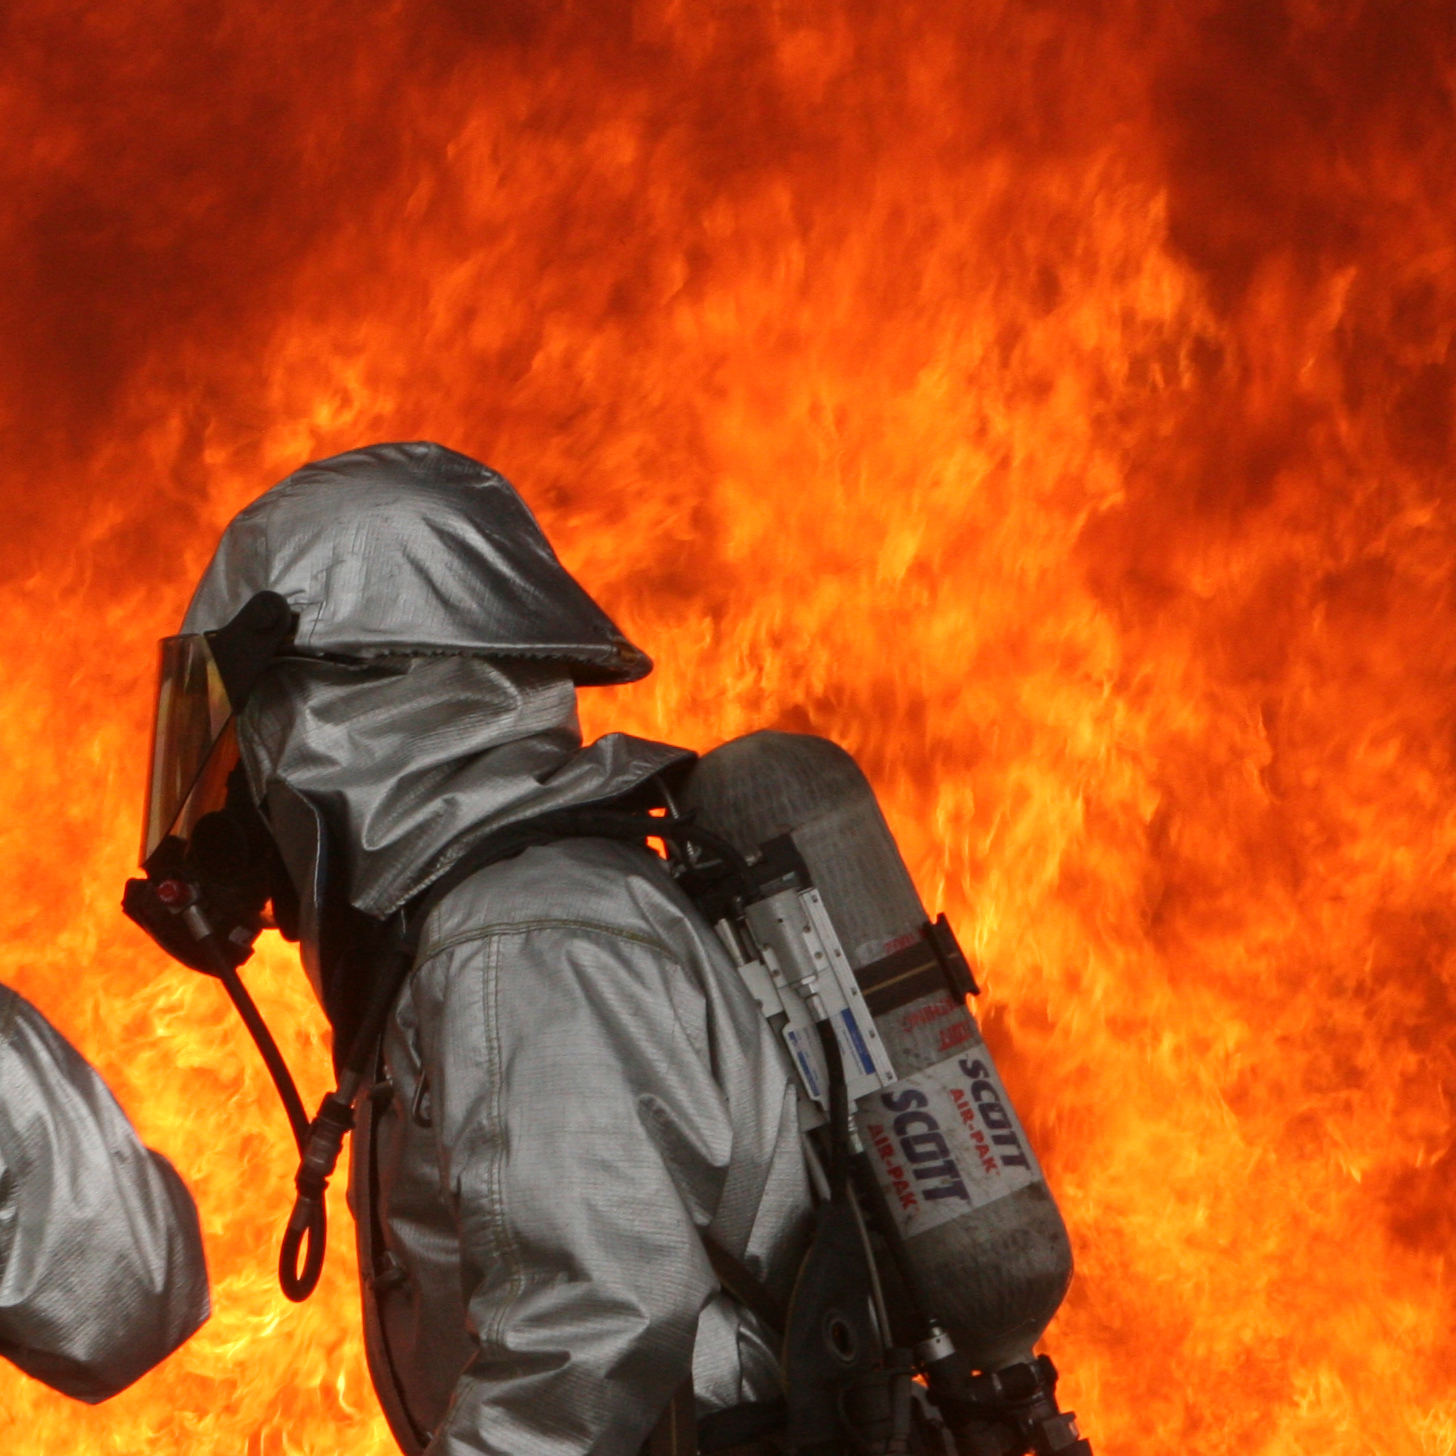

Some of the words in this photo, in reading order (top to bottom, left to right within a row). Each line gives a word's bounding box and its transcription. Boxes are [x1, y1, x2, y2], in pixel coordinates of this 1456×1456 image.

[880, 1089, 972, 1205] SCOTT
[950, 1088, 999, 1174] AIR-PAK
[959, 1058, 1031, 1171] SCOTT
[867, 1124, 920, 1210] AIR-PAK
